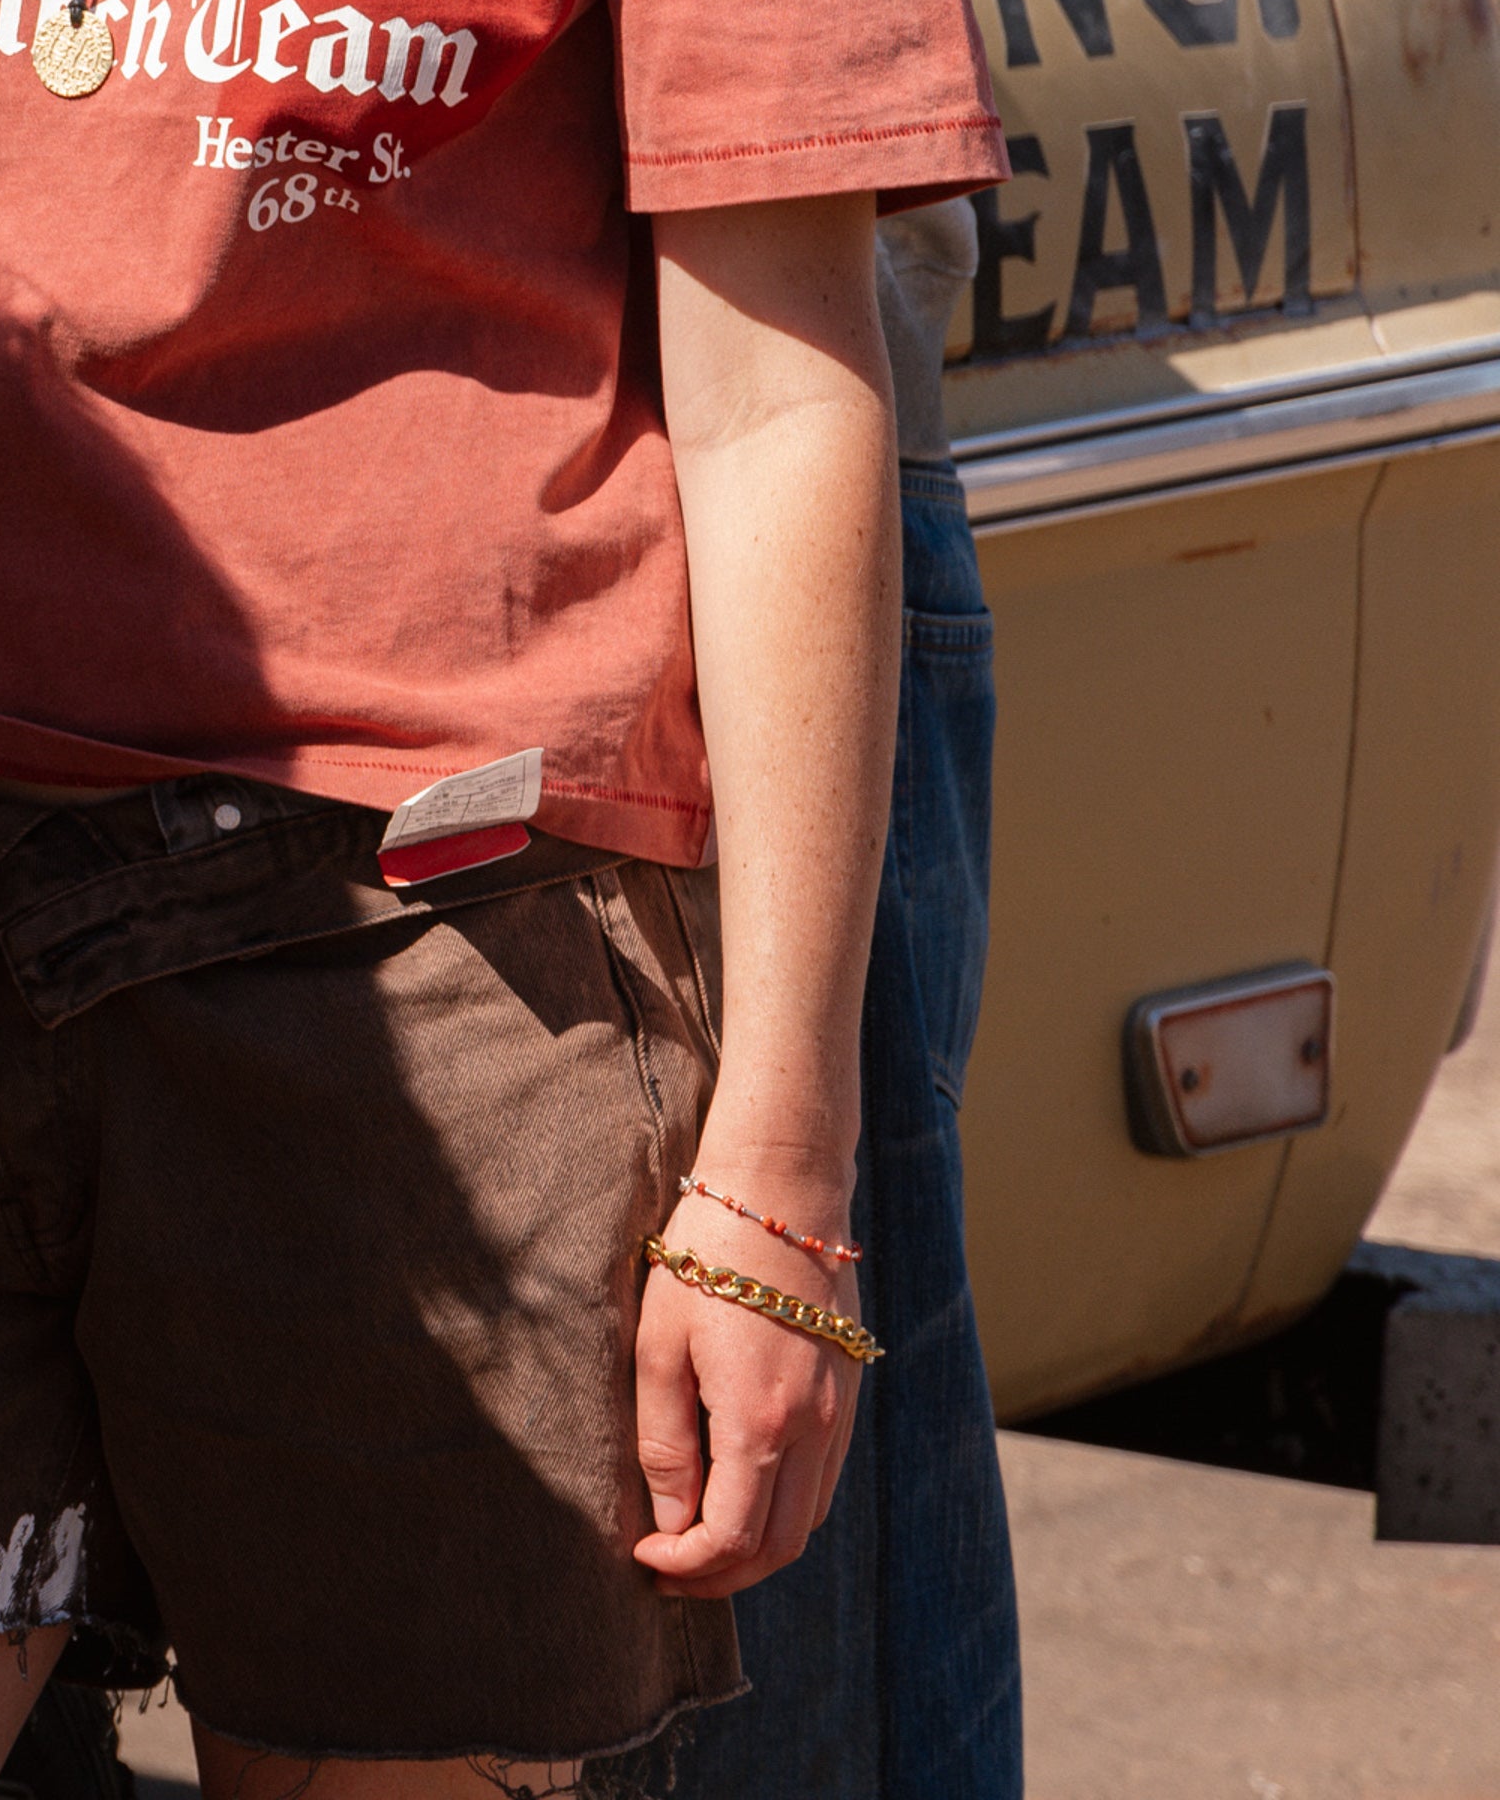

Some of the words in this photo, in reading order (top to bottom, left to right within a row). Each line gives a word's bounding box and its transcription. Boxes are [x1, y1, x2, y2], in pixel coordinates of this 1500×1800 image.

[192, 114, 360, 175] Hester
[368, 132, 412, 183] St.
[248, 172, 361, 232] 68th
